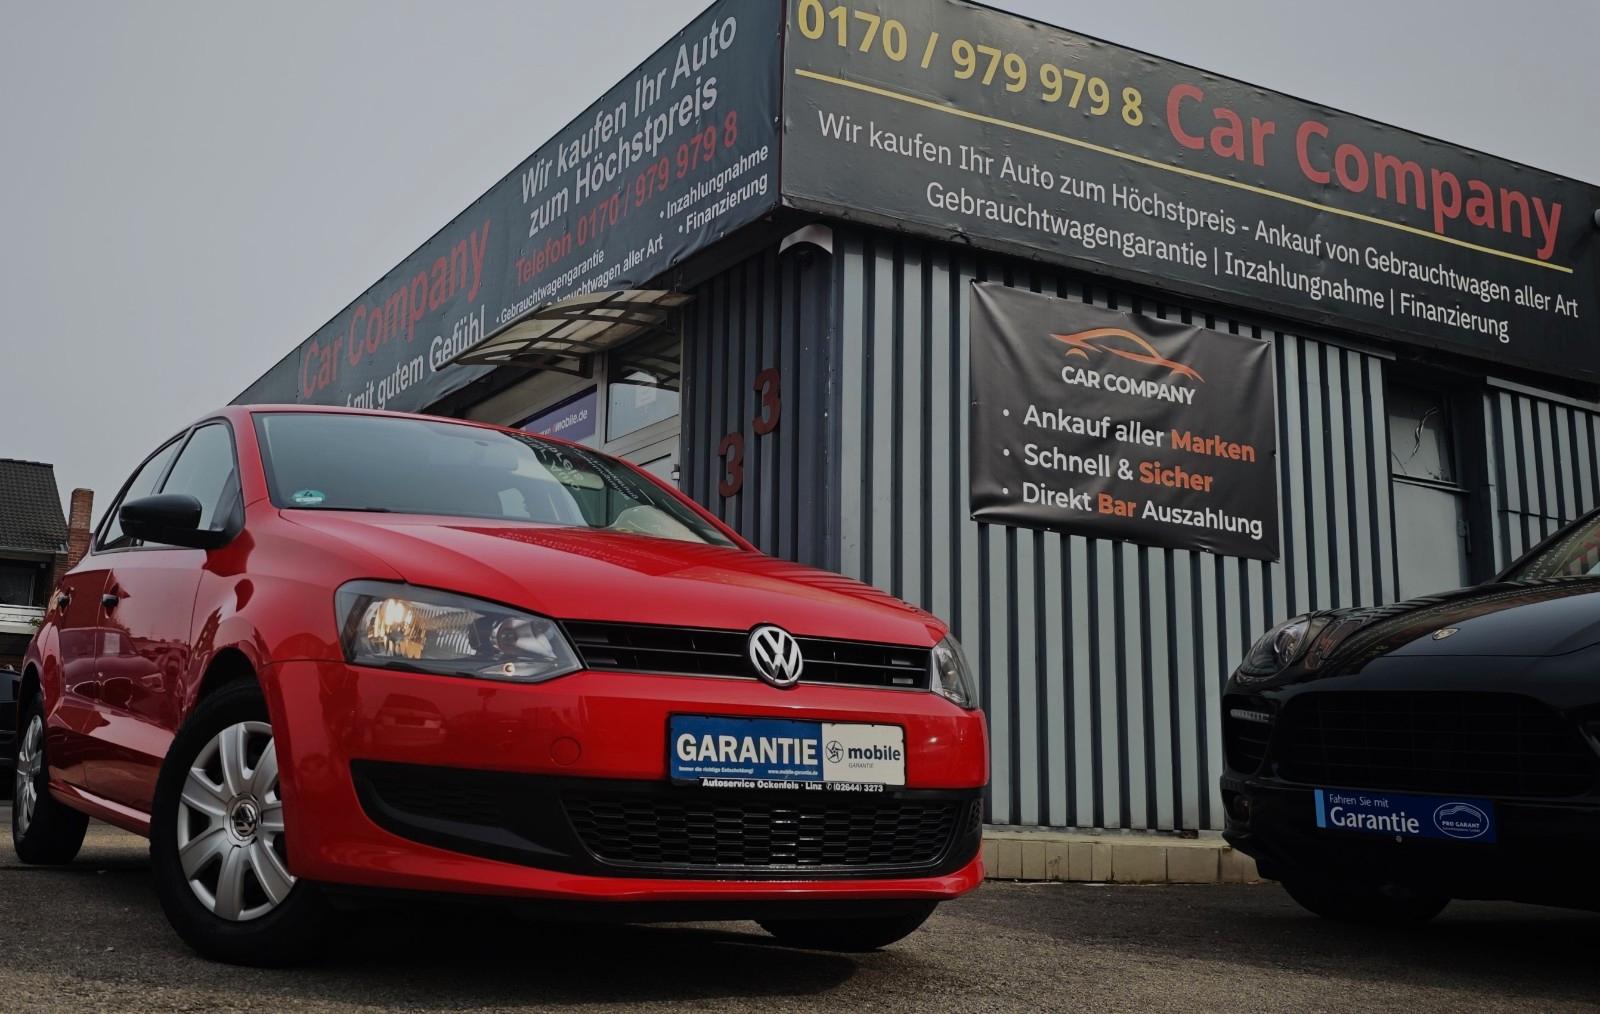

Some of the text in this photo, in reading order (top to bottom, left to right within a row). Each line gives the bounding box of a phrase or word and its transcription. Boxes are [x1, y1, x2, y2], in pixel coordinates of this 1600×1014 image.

[799, 0, 1143, 127] 0170 / 979 979 8
[521, 16, 737, 203] Wir kaufen Ihr Auto
[529, 76, 717, 238] zum Höchstpreis
[667, 145, 768, 219] Inzahlungnahme
[1166, 83, 1562, 260] Car Company
[516, 230, 572, 287] Telefon
[577, 195, 619, 246] 0170
[635, 158, 670, 208] 979
[677, 126, 716, 179] 979
[724, 111, 738, 148] 8
[686, 173, 768, 234] Finanzierung
[818, 110, 862, 144] Wir
[870, 120, 951, 166] kaufen
[960, 144, 994, 176] Ihr
[1000, 156, 1054, 190] Auto
[1060, 175, 1105, 204] zum
[1112, 183, 1236, 236] Höchstpreis
[1255, 219, 1321, 258] Ankauf
[1325, 241, 1359, 266] von
[1365, 247, 1510, 302] Gebrauchtwagen
[1515, 286, 1551, 312] aller
[1555, 293, 1579, 319] Art
[623, 248, 645, 271] aller
[647, 233, 664, 258] Art
[926, 182, 1208, 269] Gebrauchtwagengarantie
[1225, 251, 1385, 309] Inzahlungnahme
[1400, 292, 1510, 343] Finanzierung
[303, 219, 492, 400] Car Company
[501, 250, 605, 324] Gebrauchtwagengarantie
[354, 304, 486, 410] mit gutem Gefühl
[1061, 366, 1196, 405] CAR COMPANY
[753, 368, 781, 435] 3
[1023, 404, 1255, 463] Ankauf aller Marken
[718, 432, 744, 498] 3
[1024, 444, 1213, 493] Schnell & Sicher
[1023, 482, 1263, 540] Direkt Bar Auszahlung
[676, 733, 818, 766] GARANTIE
[848, 745, 901, 761] mobile
[702, 778, 884, 792] Autoservice Ockenfels Linz (02644) 3273
[1329, 794, 1389, 808] Fahren Sie mit
[1330, 806, 1420, 834] Garantie
